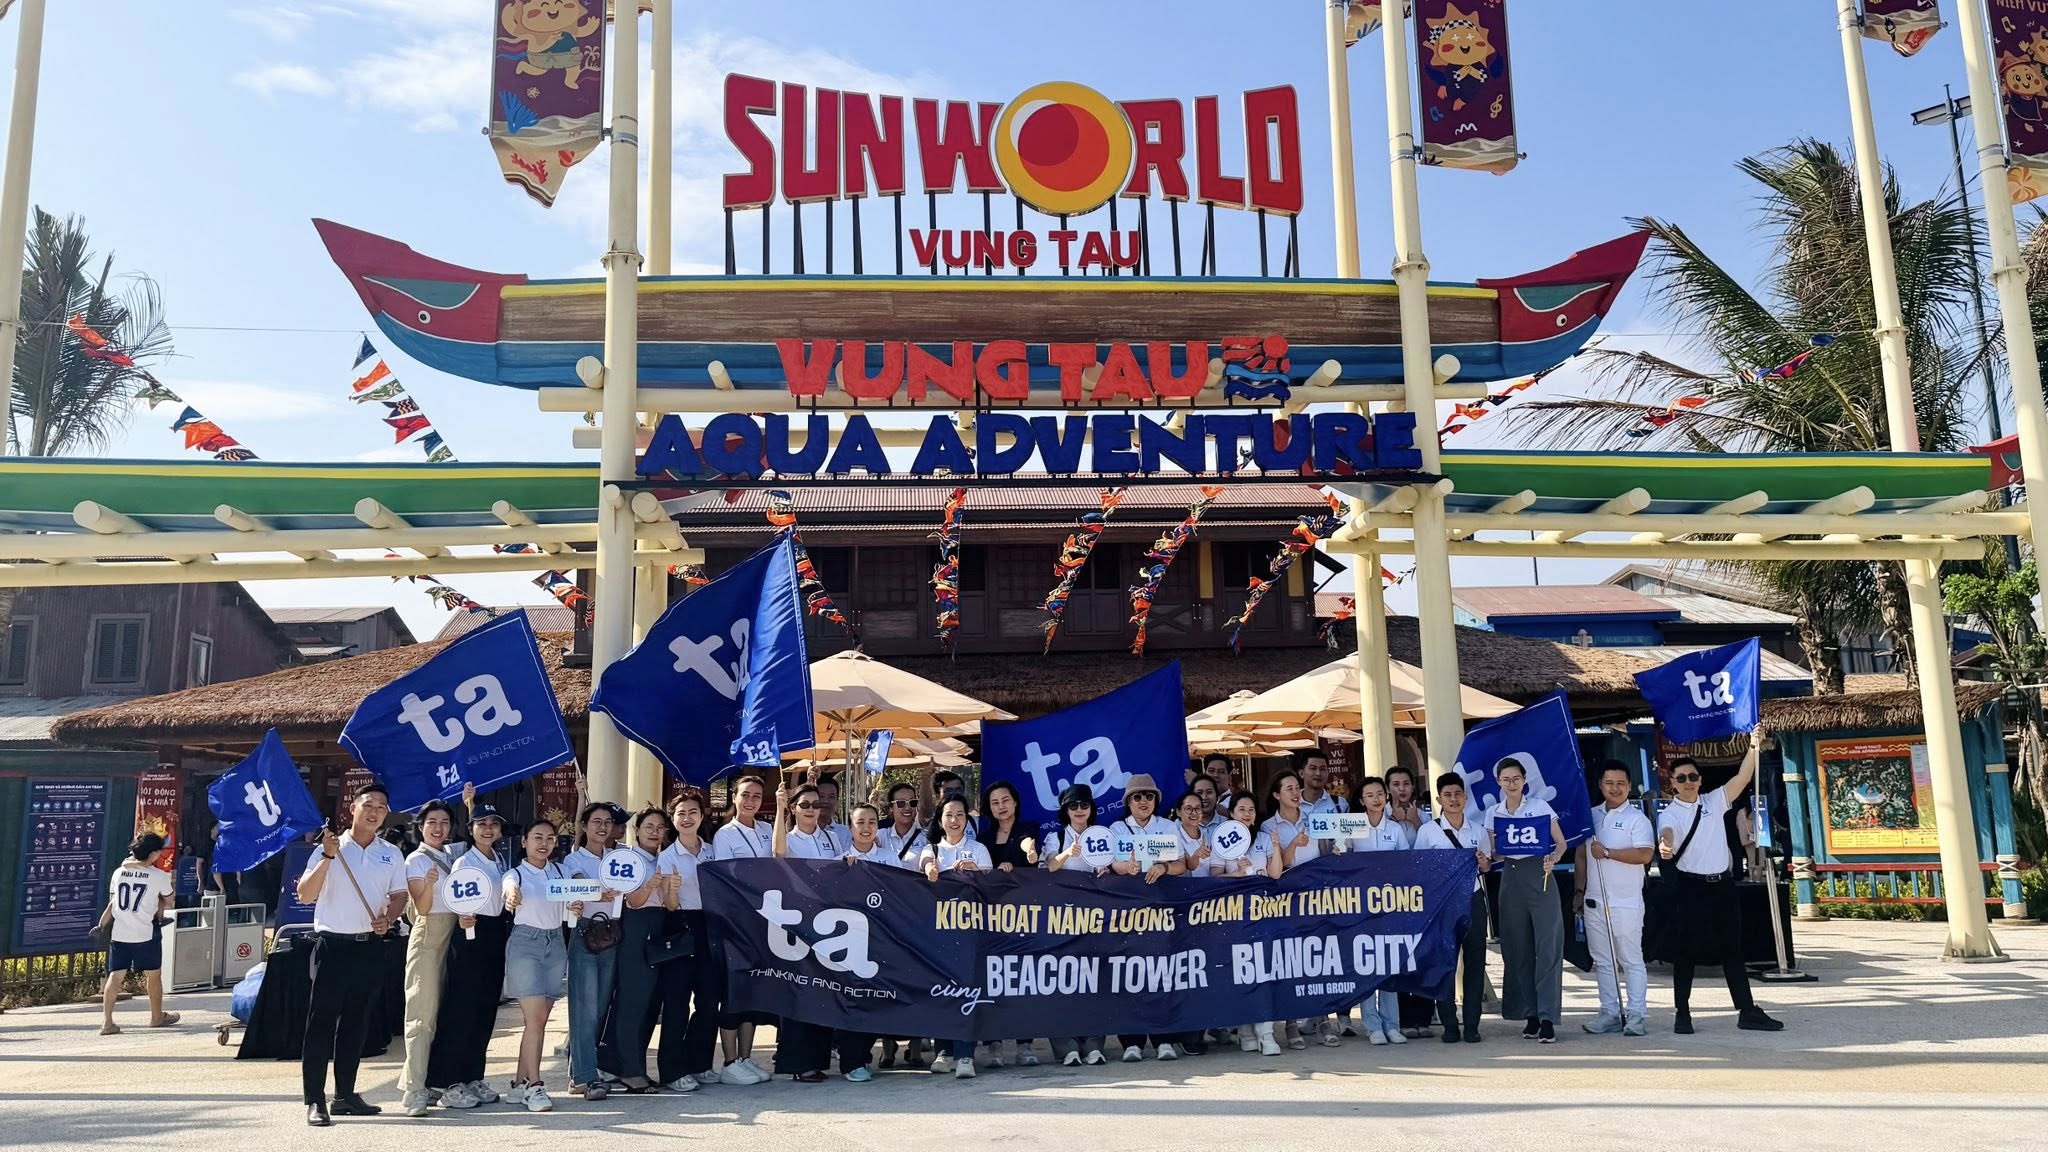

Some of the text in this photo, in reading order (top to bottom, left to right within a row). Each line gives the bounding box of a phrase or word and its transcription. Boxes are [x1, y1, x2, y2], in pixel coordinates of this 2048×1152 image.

[908, 228, 1141, 270] VUNG TAU
[776, 338, 1208, 401] VUNG TAU
[635, 411, 1424, 479] AQUA ADVENTURE
[1683, 670, 1734, 709] ta
[397, 673, 522, 753] ta
[743, 740, 773, 763] ta
[435, 762, 461, 789] ta
[1020, 736, 1133, 812] ta
[1217, 827, 1243, 849] ta
[1312, 818, 1328, 831] ta
[1506, 823, 1540, 845] ta
[1086, 836, 1110, 853] ta
[1118, 840, 1134, 853] ta
[609, 858, 635, 879] ta
[118, 882, 147, 912] 07
[451, 879, 481, 899] ta
[550, 884, 562, 894] ta
[935, 897, 984, 930] KÍCH
[987, 903, 1042, 937] HOẠT
[1047, 903, 1104, 936] NĂNG
[1108, 906, 1176, 936] LƯỢNG
[1188, 894, 1244, 926] CHẠM
[1298, 885, 1361, 916] THÀNH
[1367, 883, 1424, 914] CÔNG
[756, 889, 879, 979] ta
[749, 967, 897, 999] THINKING AND ACTION
[930, 979, 995, 1016] cùng
[986, 954, 1100, 997] BEACON
[1108, 949, 1208, 994] TOWER
[1232, 934, 1344, 985] BLANCA
[1352, 933, 1423, 976] CITY
[1295, 982, 1356, 997] BY SUN GROUP
